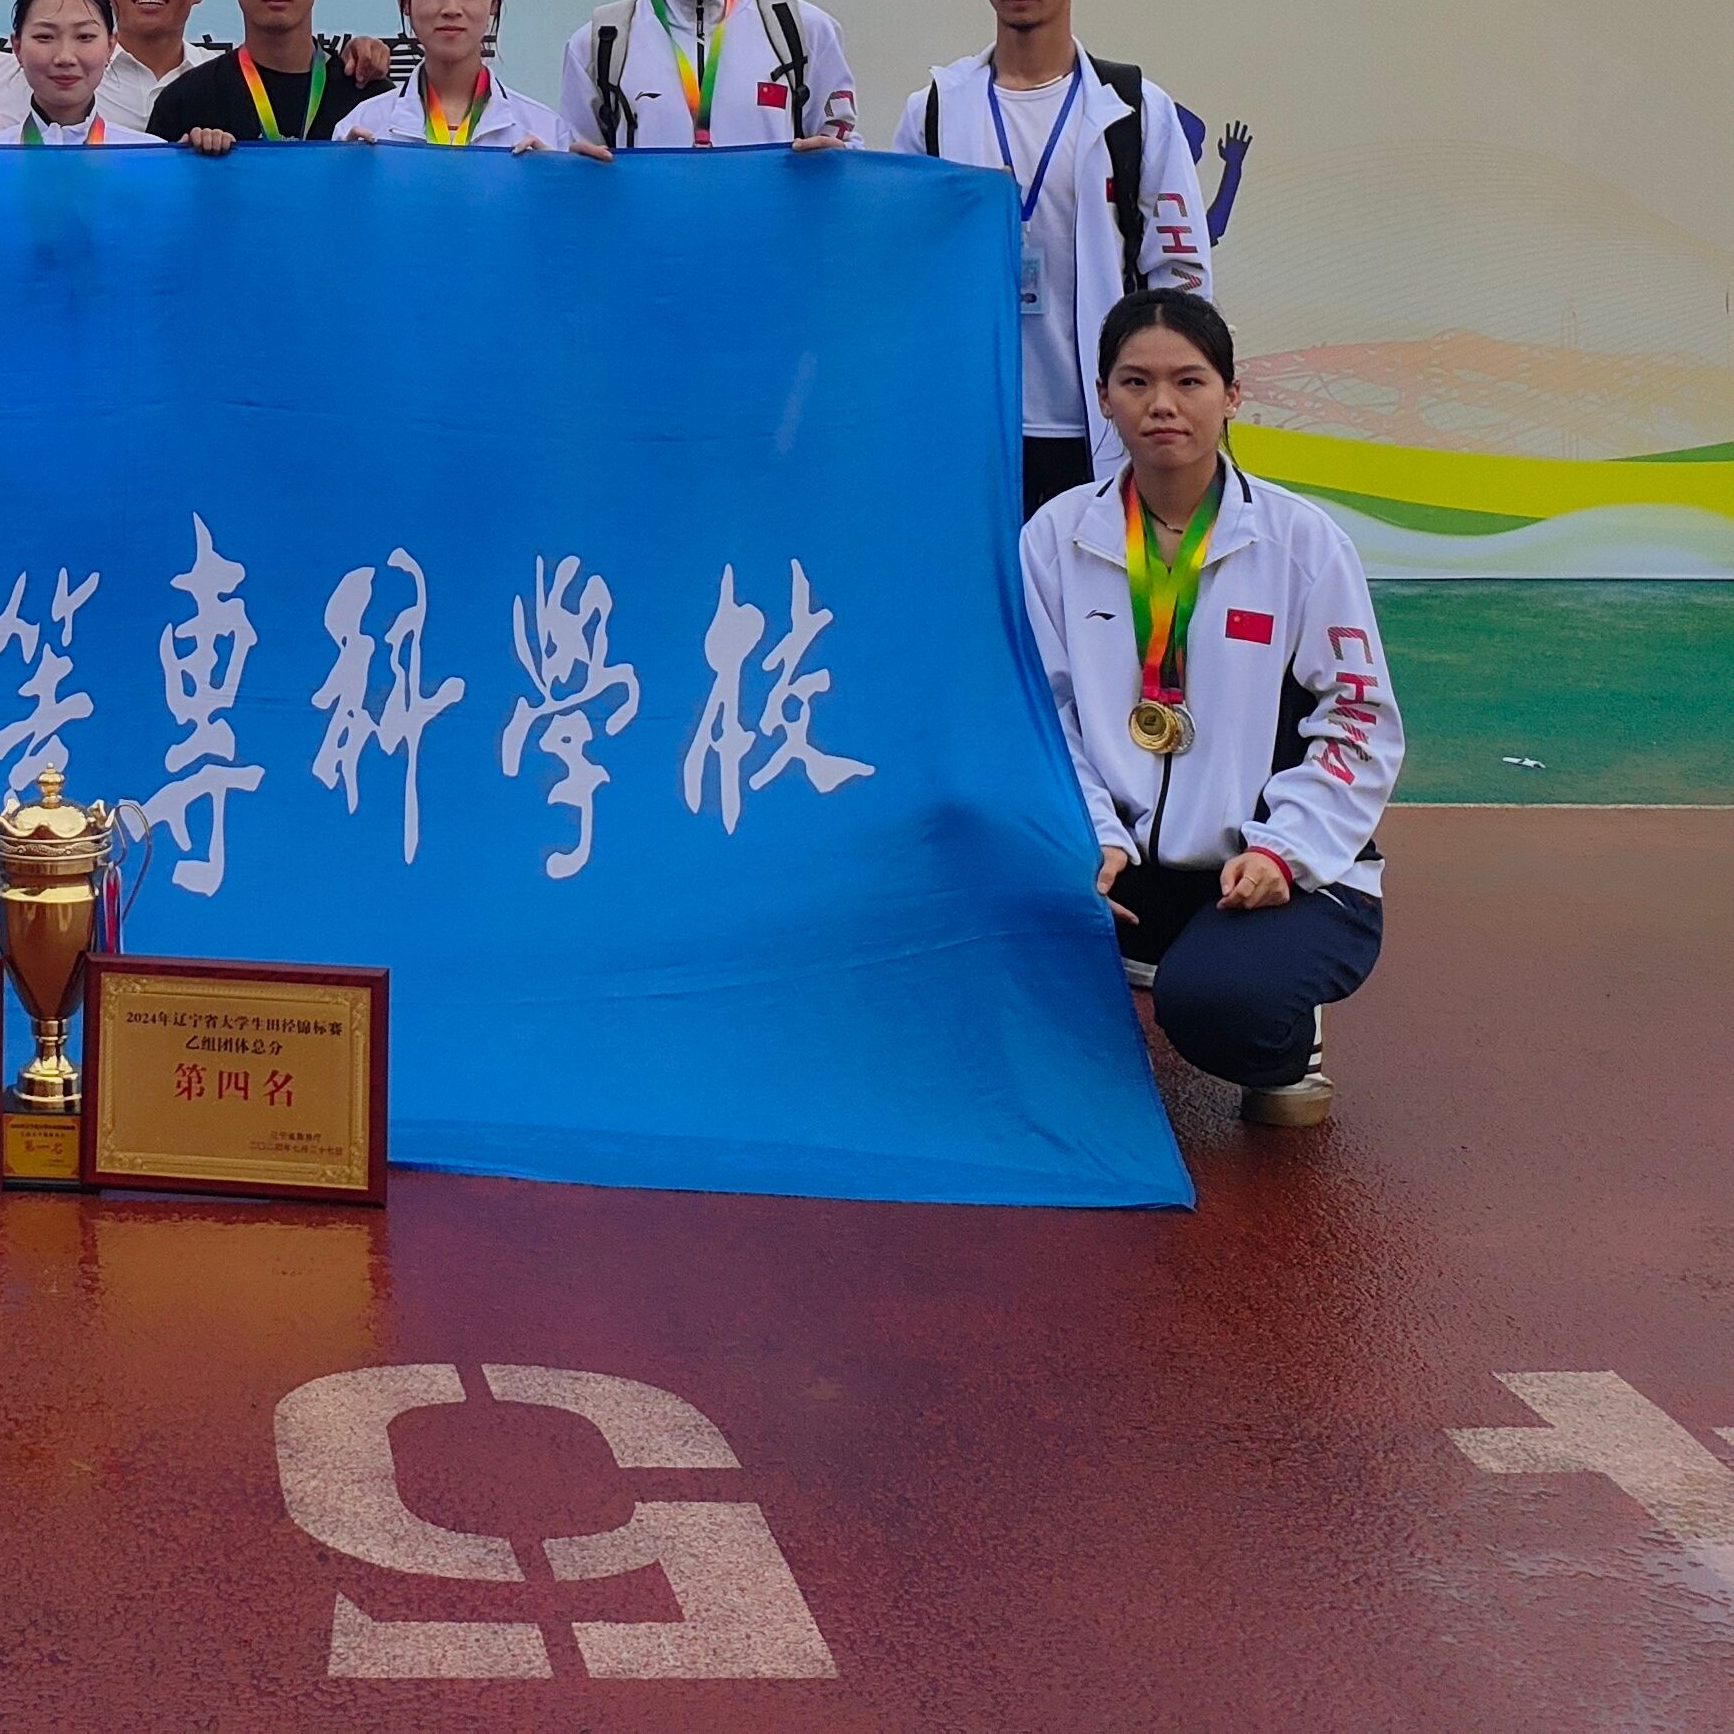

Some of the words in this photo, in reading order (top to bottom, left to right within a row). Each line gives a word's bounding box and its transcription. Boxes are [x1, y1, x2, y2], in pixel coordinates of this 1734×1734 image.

[126, 1011, 343, 1036] 2024年辽宁省大学生田径锦标赛
[185, 1035, 283, 1055] 乙组团体总分
[174, 1063, 294, 1107] 第四名
[273, 1363, 839, 1679] 5
